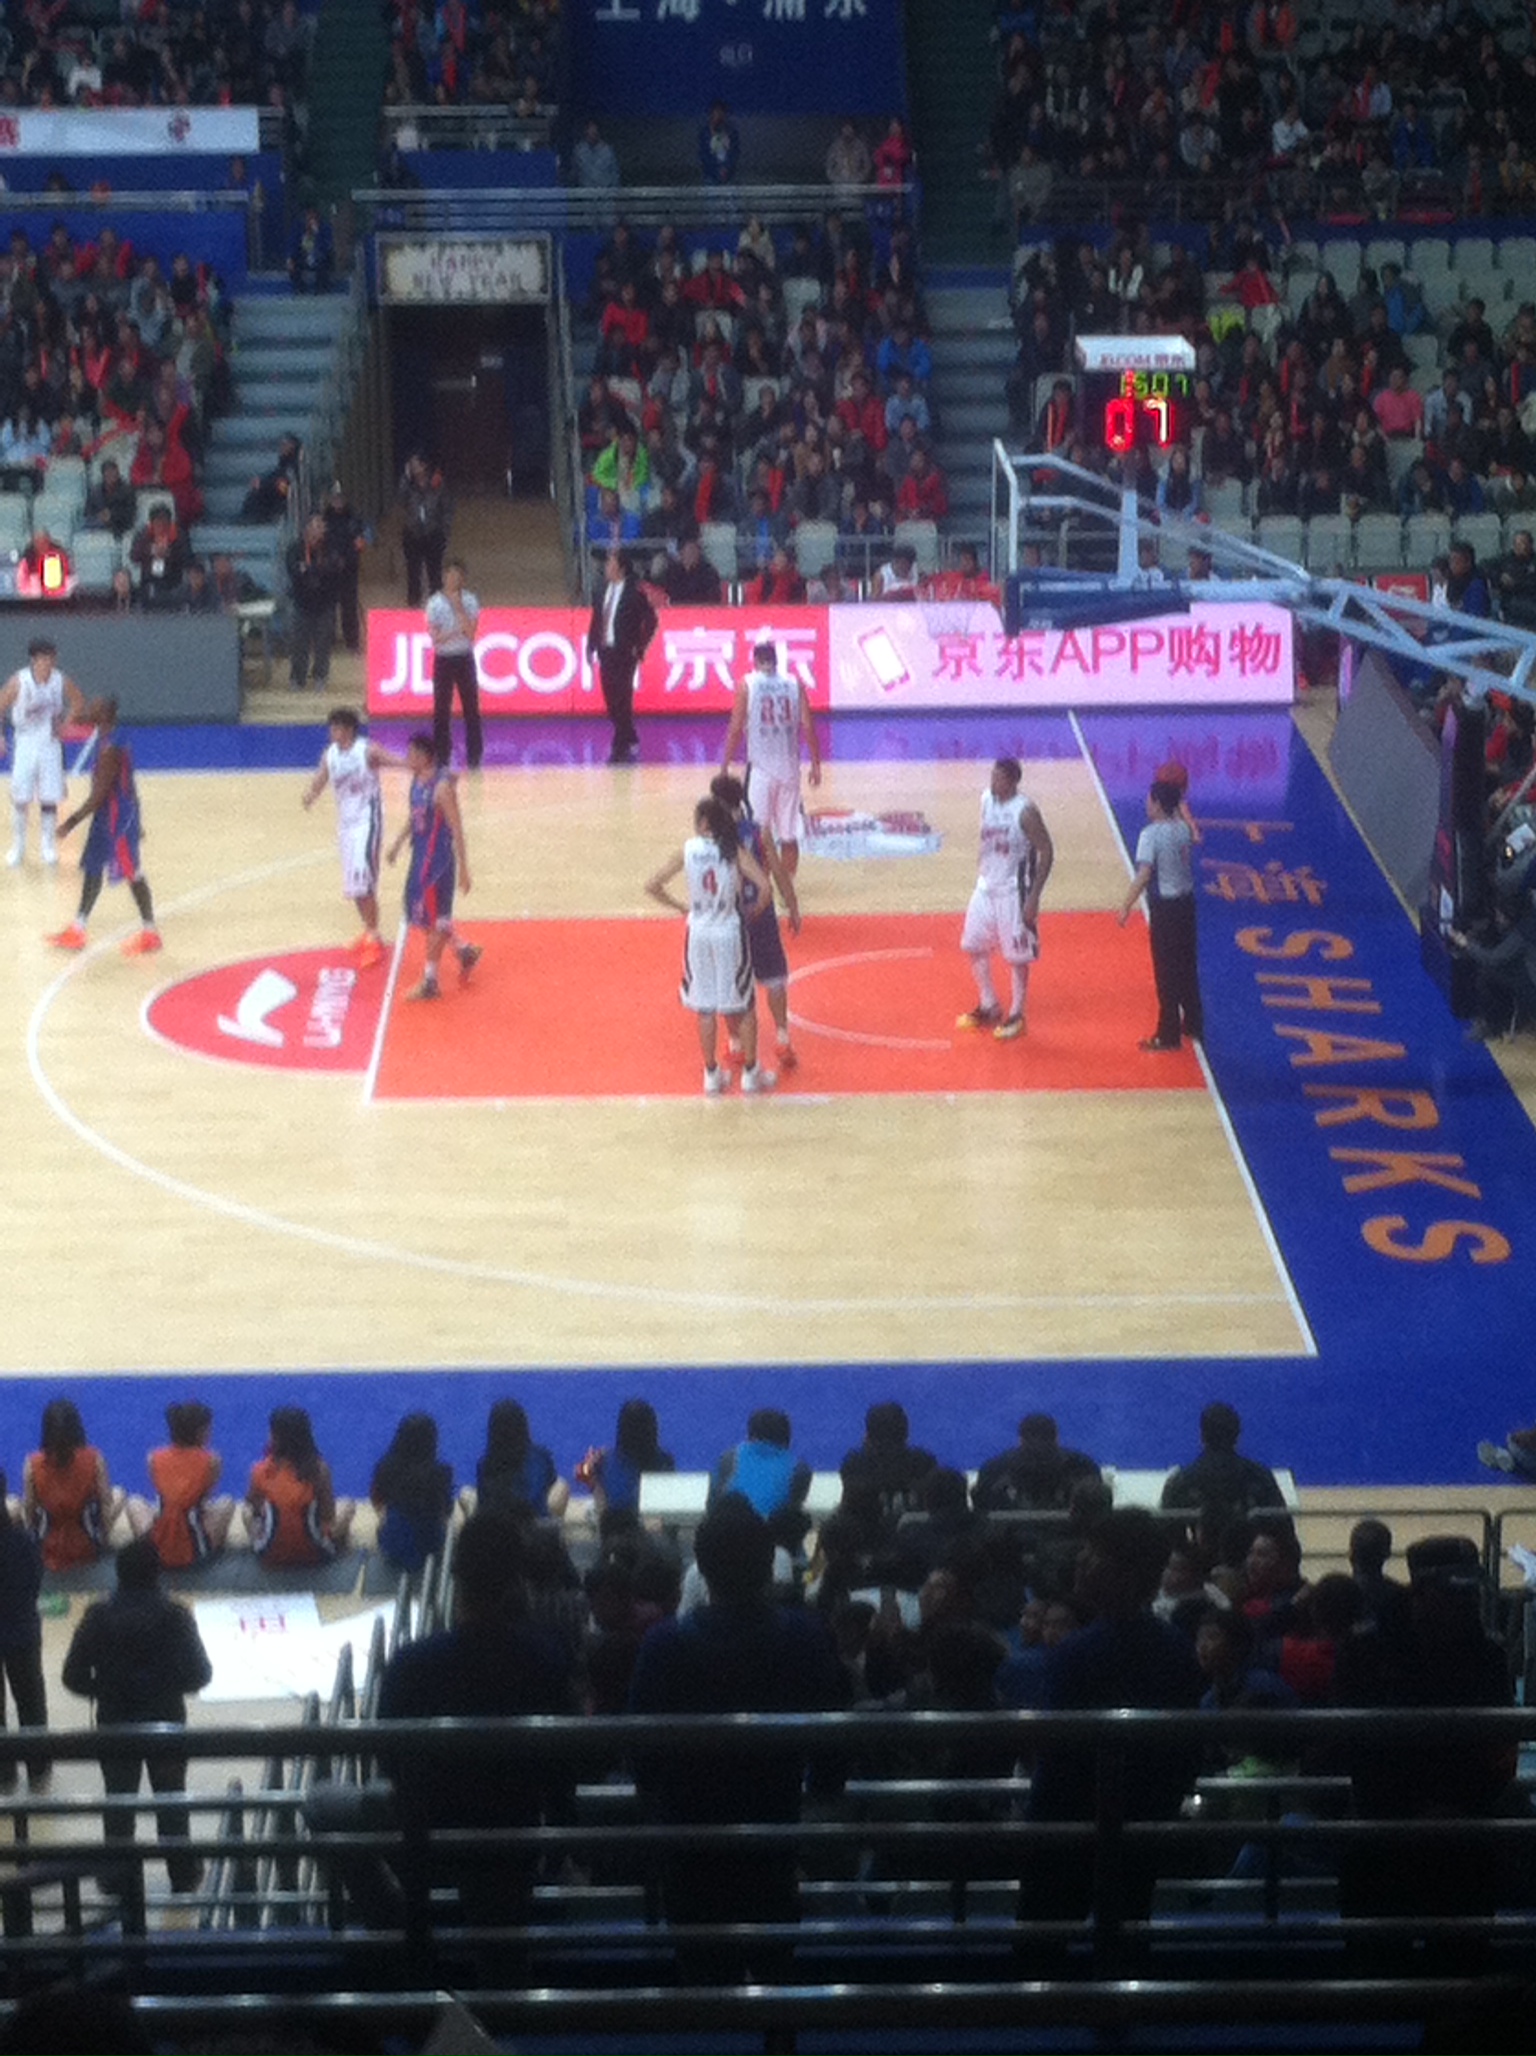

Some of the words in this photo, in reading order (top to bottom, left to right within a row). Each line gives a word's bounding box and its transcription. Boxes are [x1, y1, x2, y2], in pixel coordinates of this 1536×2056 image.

[380, 631, 641, 695] JDCO
[933, 621, 1282, 681] 京东APP购物
[1235, 926, 1512, 1265] SHARKS
